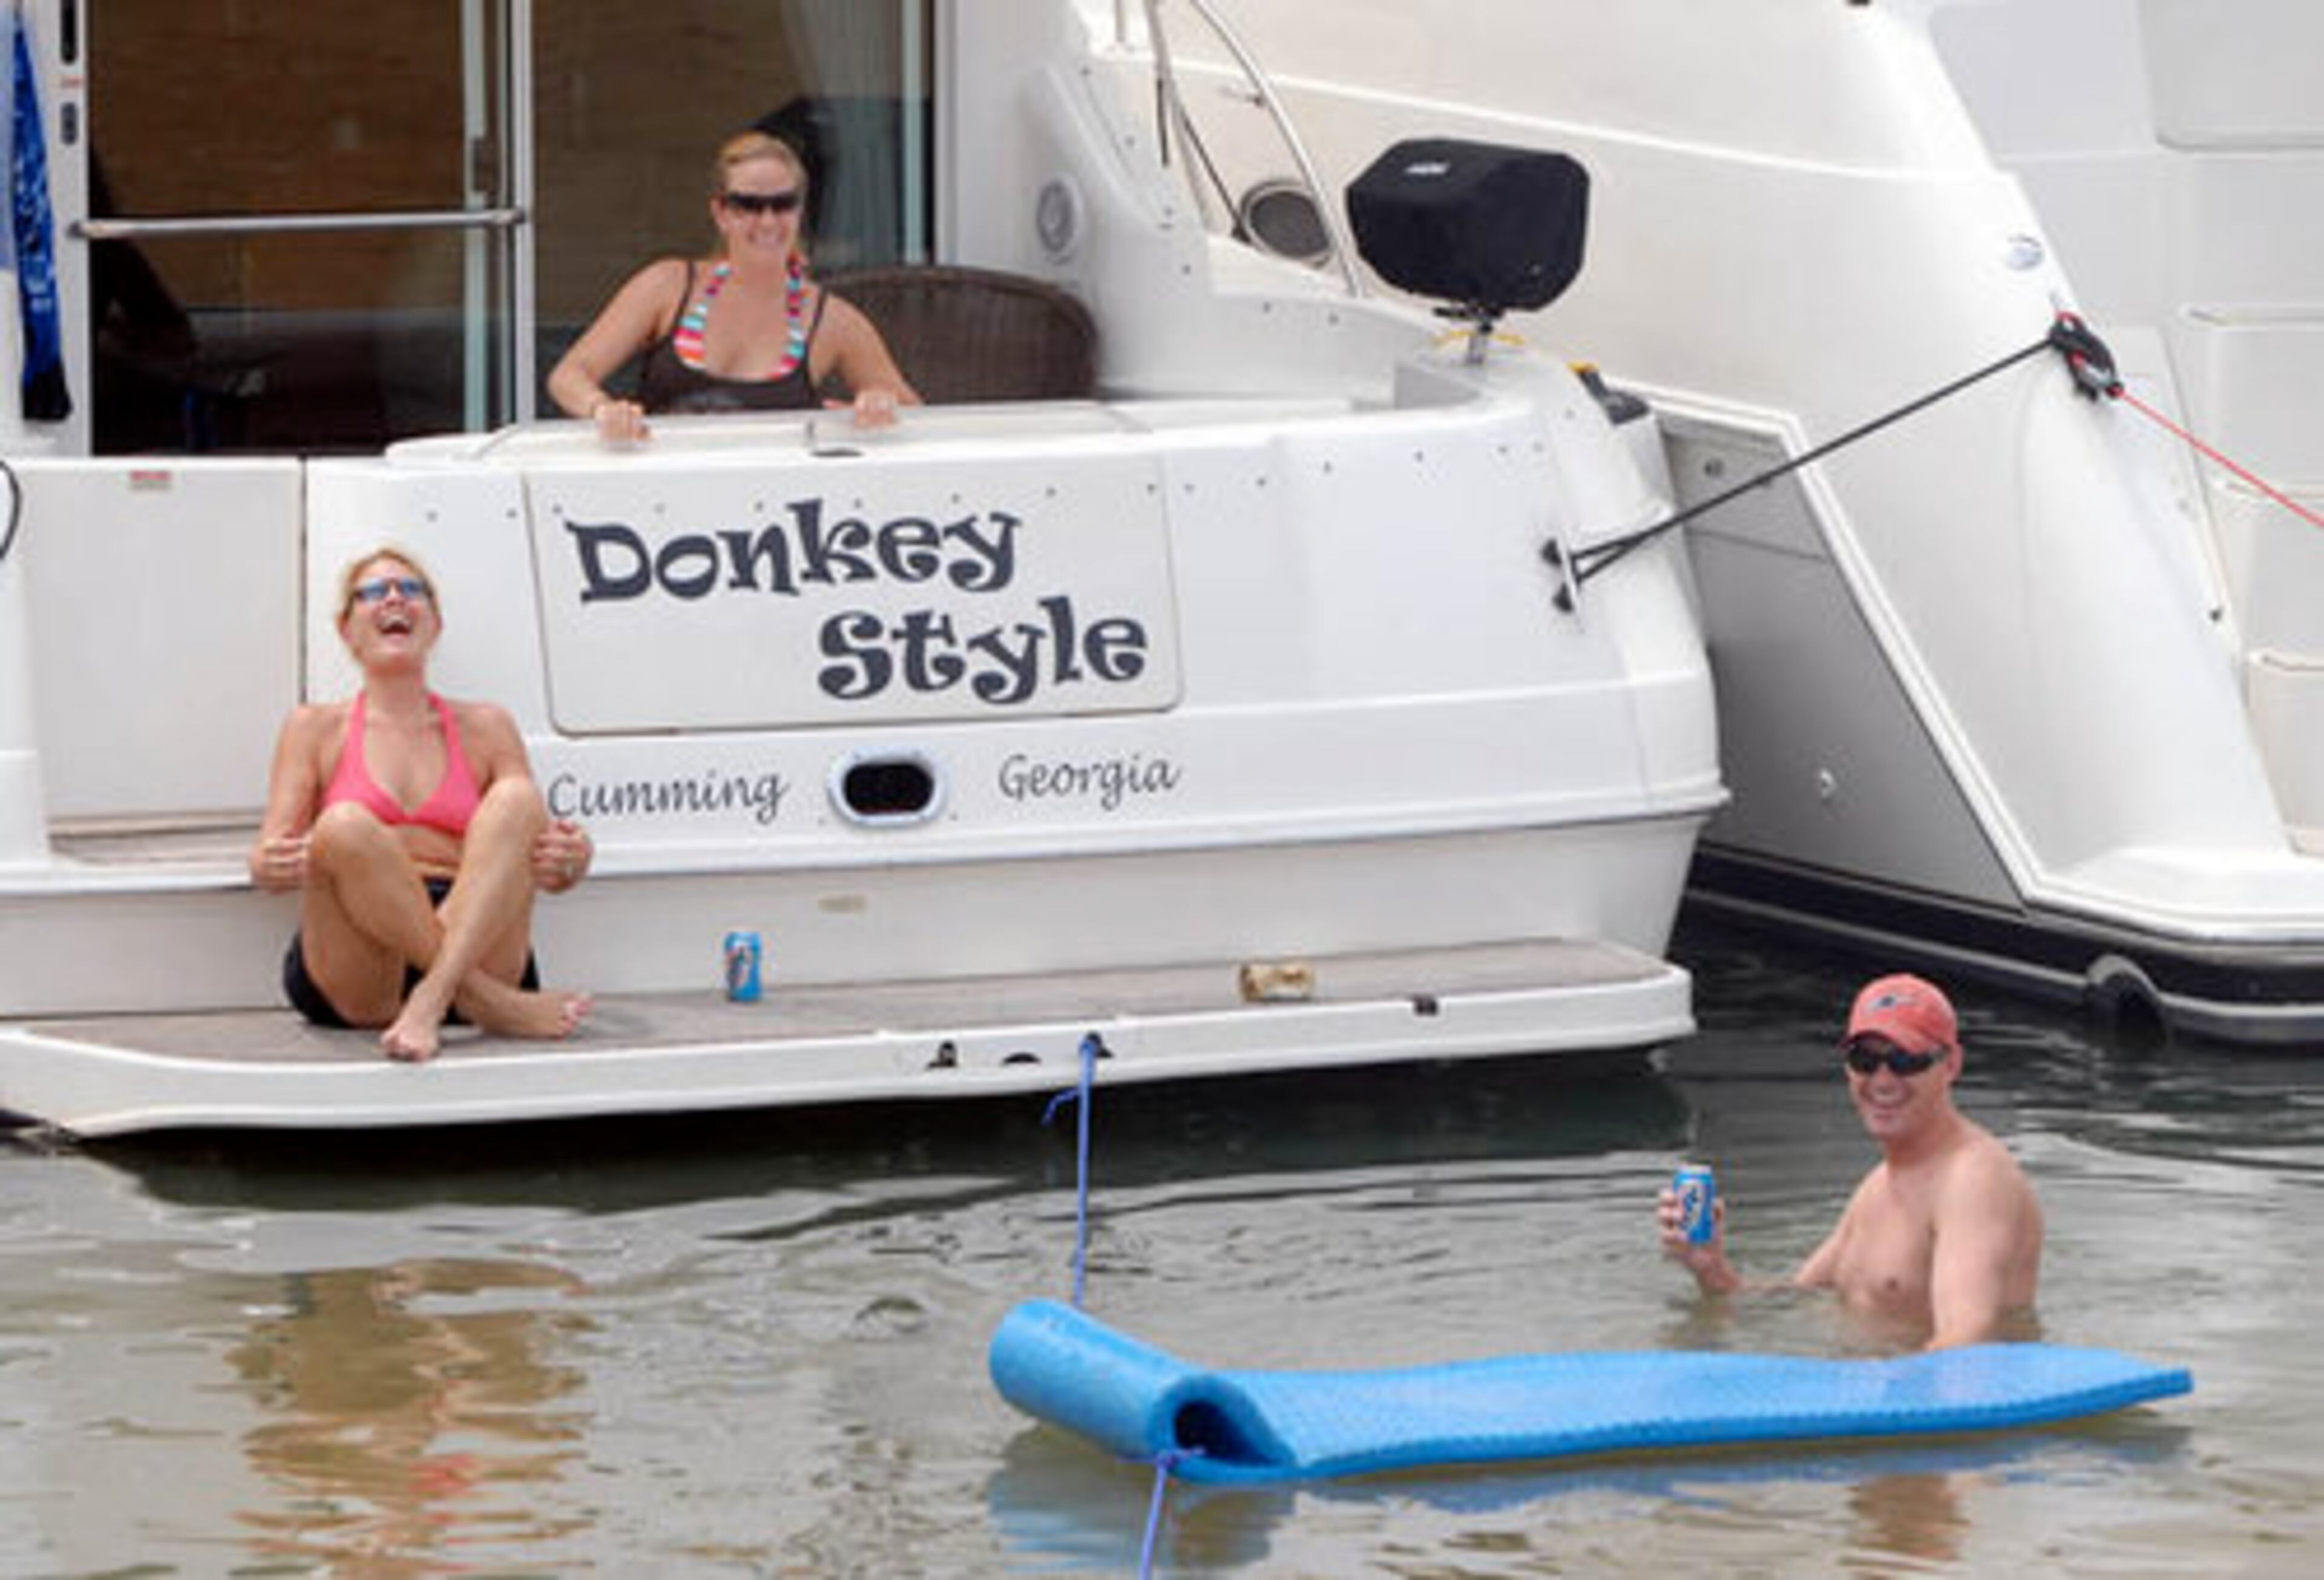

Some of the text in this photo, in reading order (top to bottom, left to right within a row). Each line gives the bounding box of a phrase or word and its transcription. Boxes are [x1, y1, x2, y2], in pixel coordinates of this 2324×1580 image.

[565, 498, 1023, 603] Donkey
[818, 596, 1148, 706] Style
[547, 752, 1183, 825] Cumming Georgia
